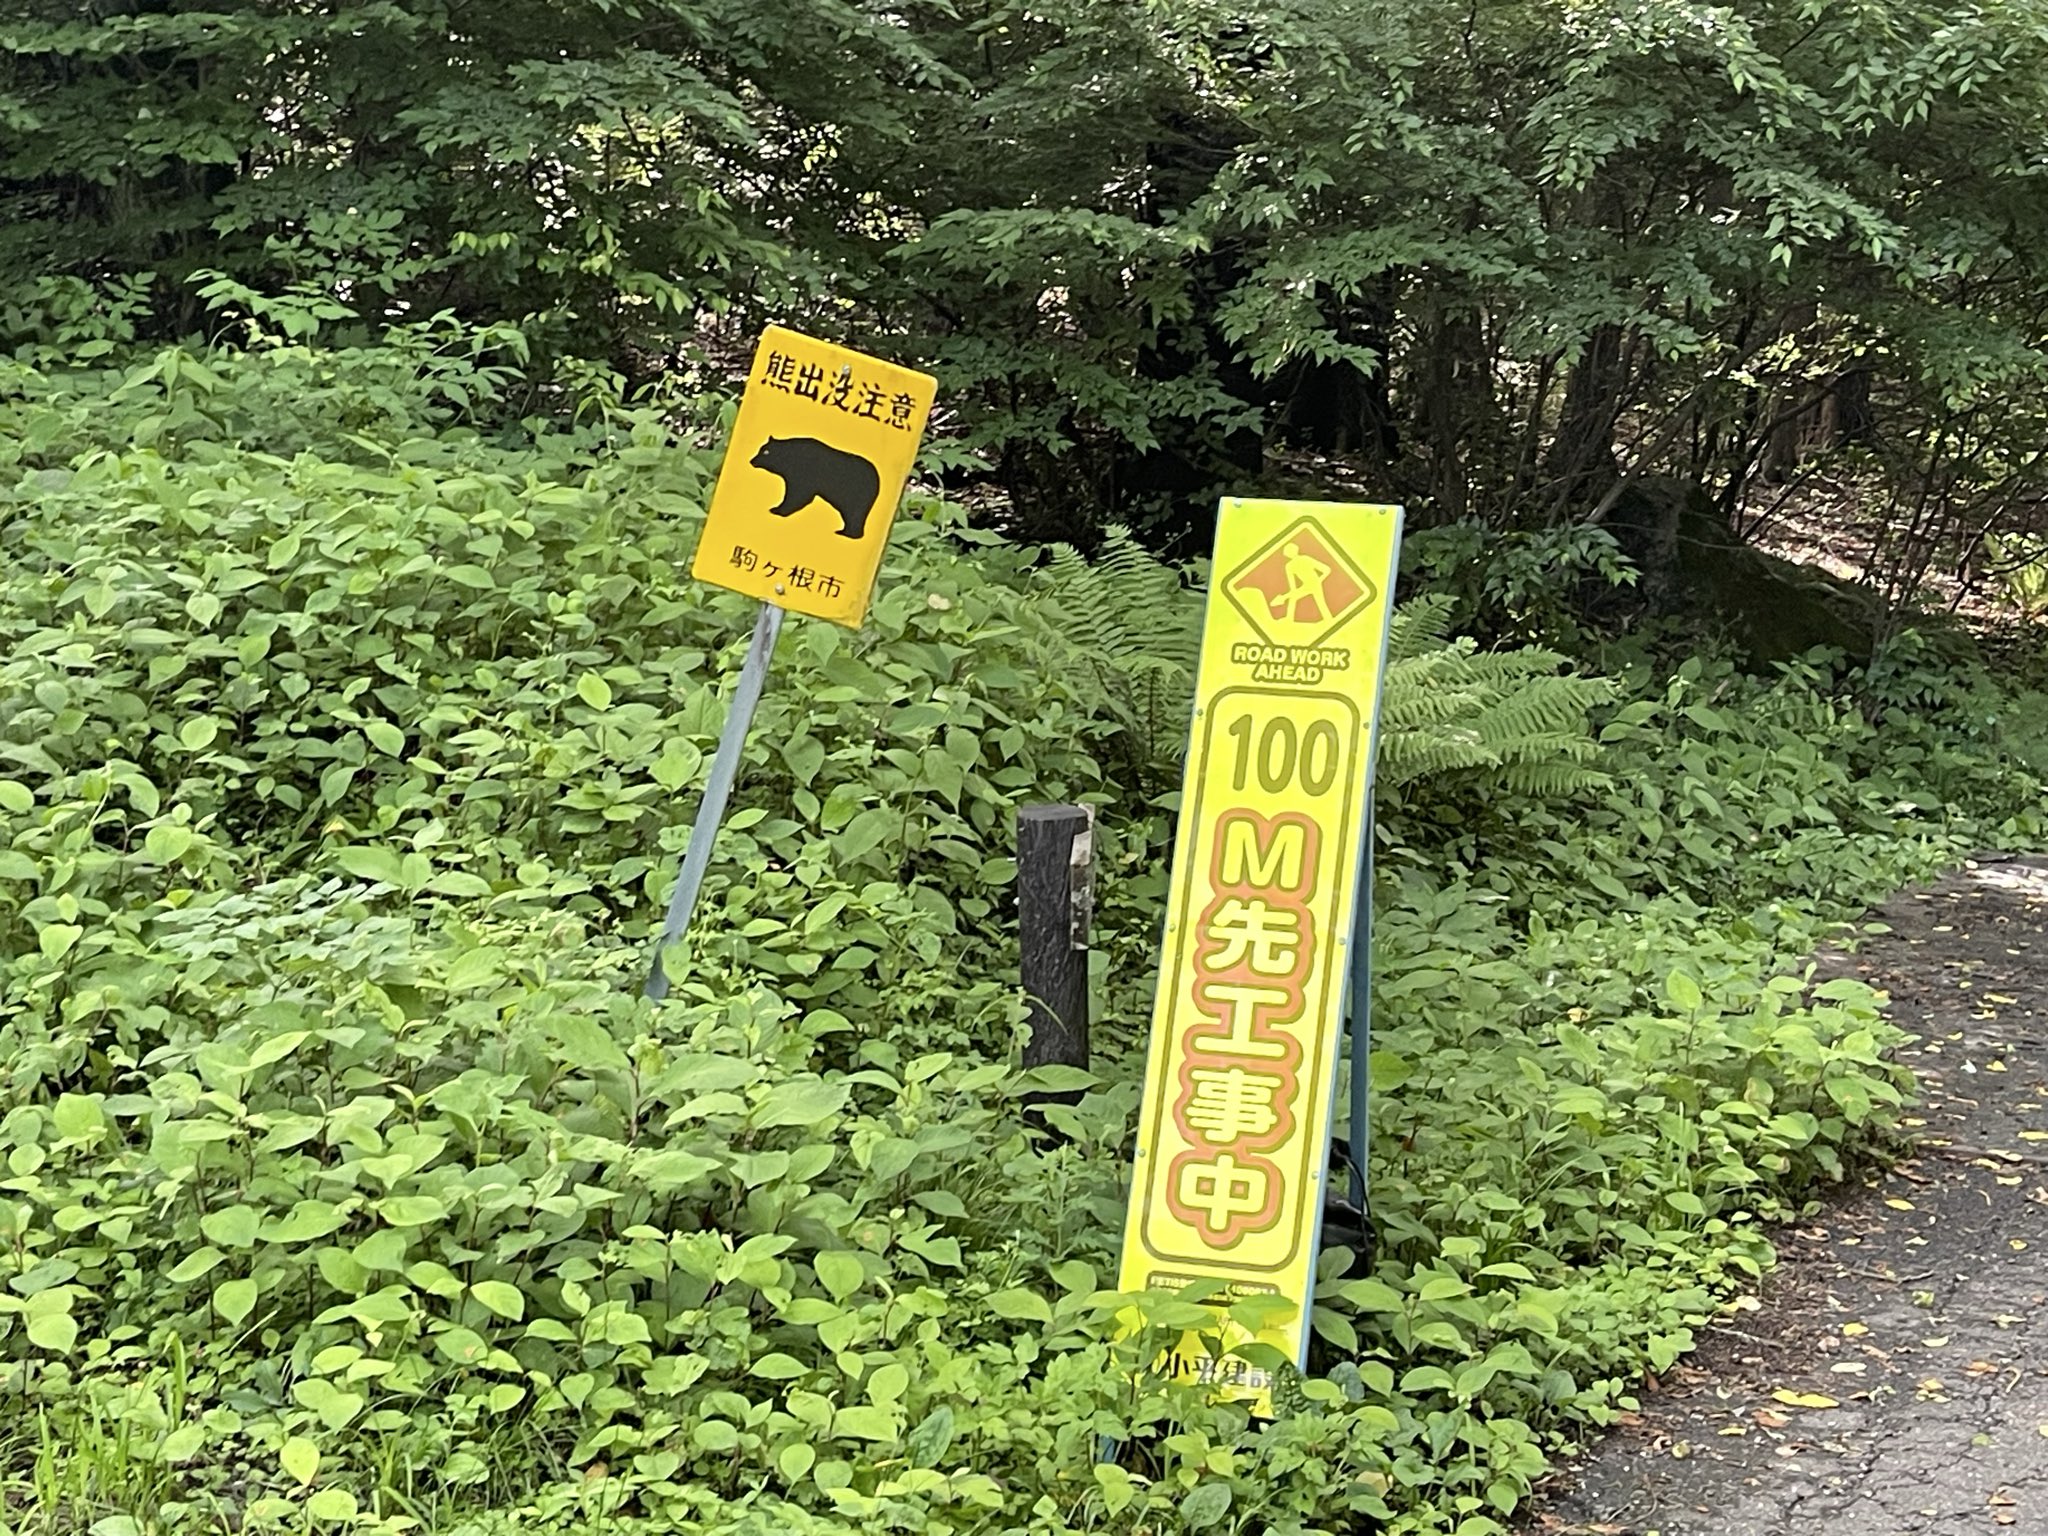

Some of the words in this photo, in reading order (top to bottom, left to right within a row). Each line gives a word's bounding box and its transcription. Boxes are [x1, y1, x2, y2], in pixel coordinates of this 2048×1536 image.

[761, 351, 917, 431] 熊出没注意
[1233, 646, 1287, 664] ROAD
[1290, 648, 1348, 667] WORK
[1254, 665, 1321, 682] AHEAD
[1229, 713, 1339, 797] 100
